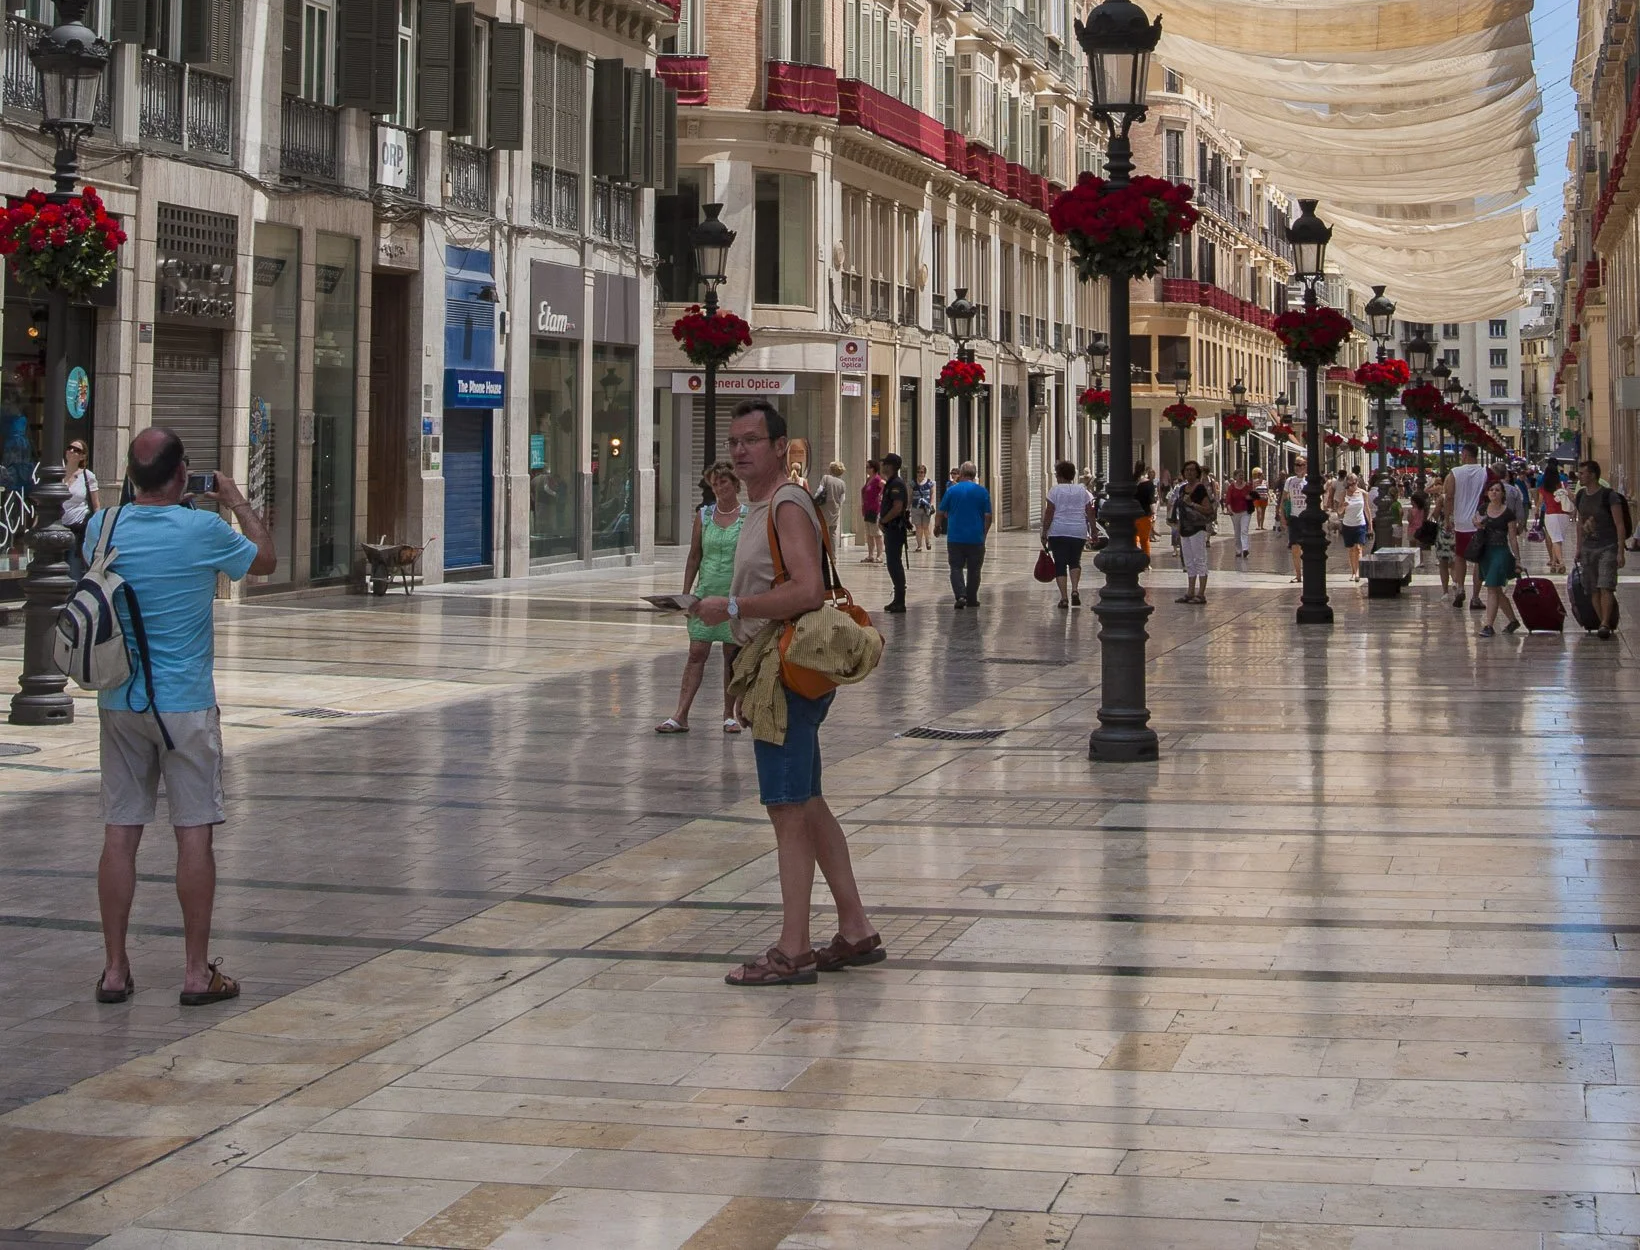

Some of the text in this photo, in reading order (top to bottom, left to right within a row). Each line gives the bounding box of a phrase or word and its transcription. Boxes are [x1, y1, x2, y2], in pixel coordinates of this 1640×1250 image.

[382, 141, 404, 168] ORP
[538, 301, 567, 332] Etam
[457, 379, 502, 395] The Phone House
[713, 378, 780, 390] eneral Optica
